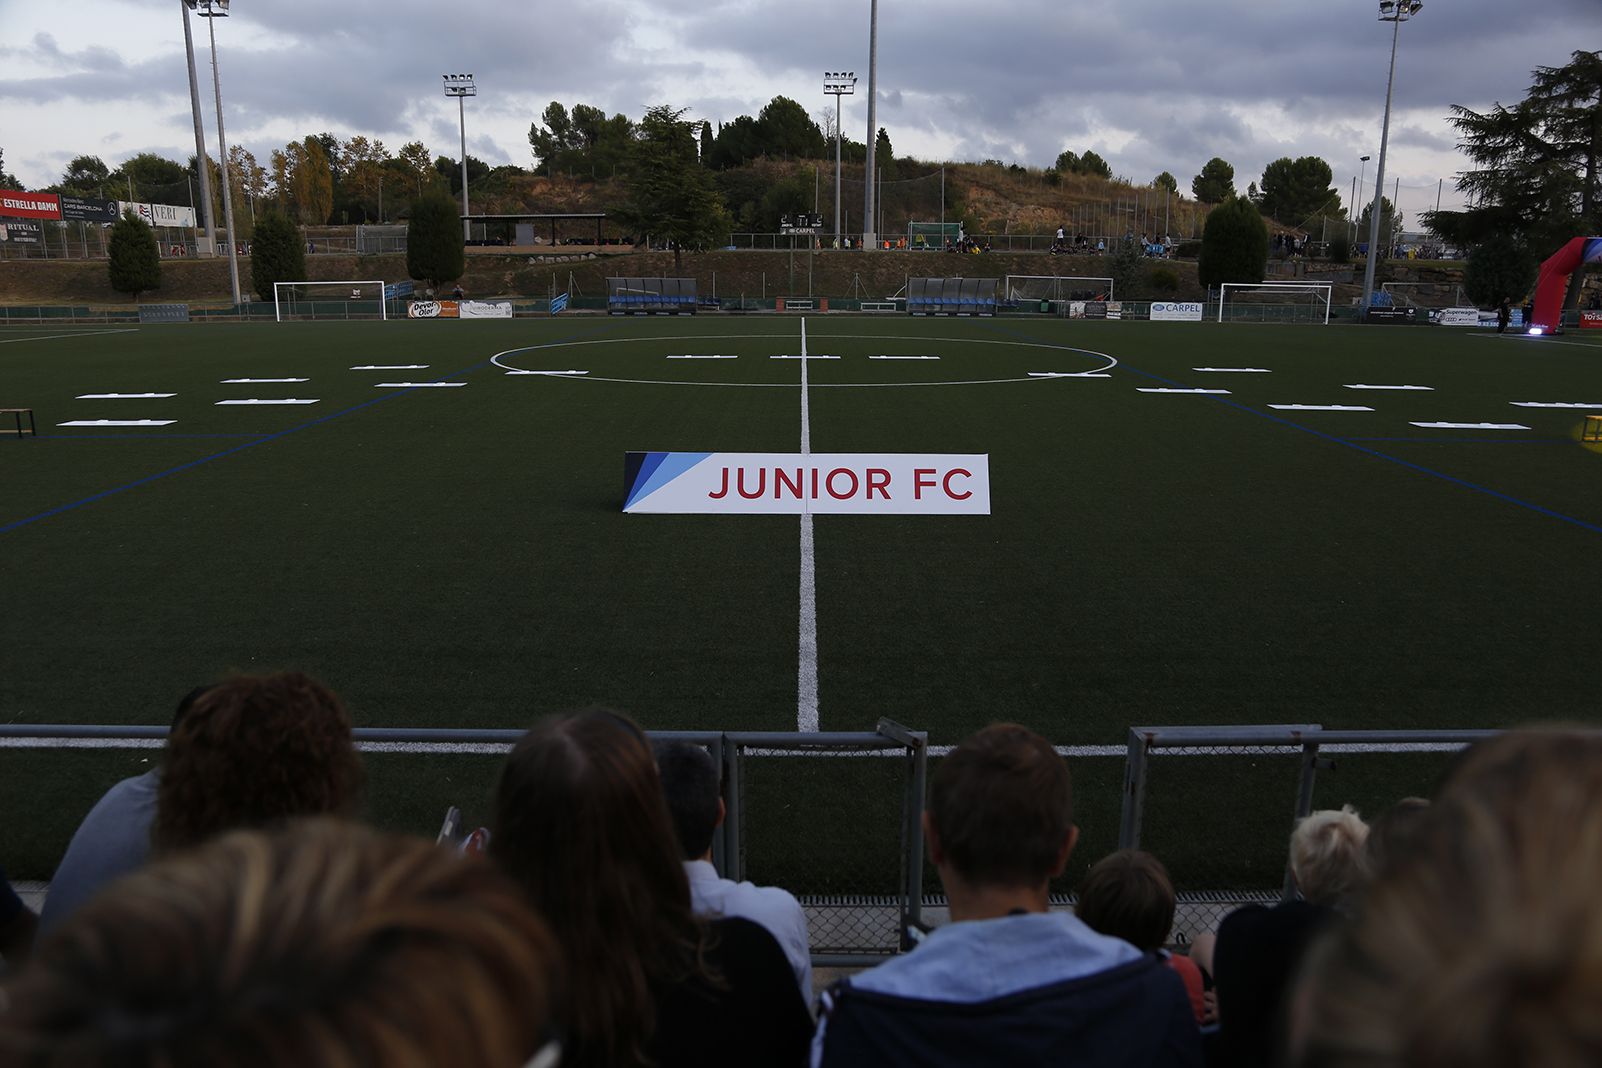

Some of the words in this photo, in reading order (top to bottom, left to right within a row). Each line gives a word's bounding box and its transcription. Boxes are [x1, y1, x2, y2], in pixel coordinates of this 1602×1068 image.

[4, 198, 37, 210] ESTRELLA
[37, 202, 58, 211] DAMM
[7, 223, 39, 231] RITUAL
[414, 302, 436, 310] Devor
[1165, 304, 1200, 312] CARPEL
[419, 308, 433, 316] Olor
[708, 467, 891, 500] JUNIOR
[913, 468, 973, 500] FC
